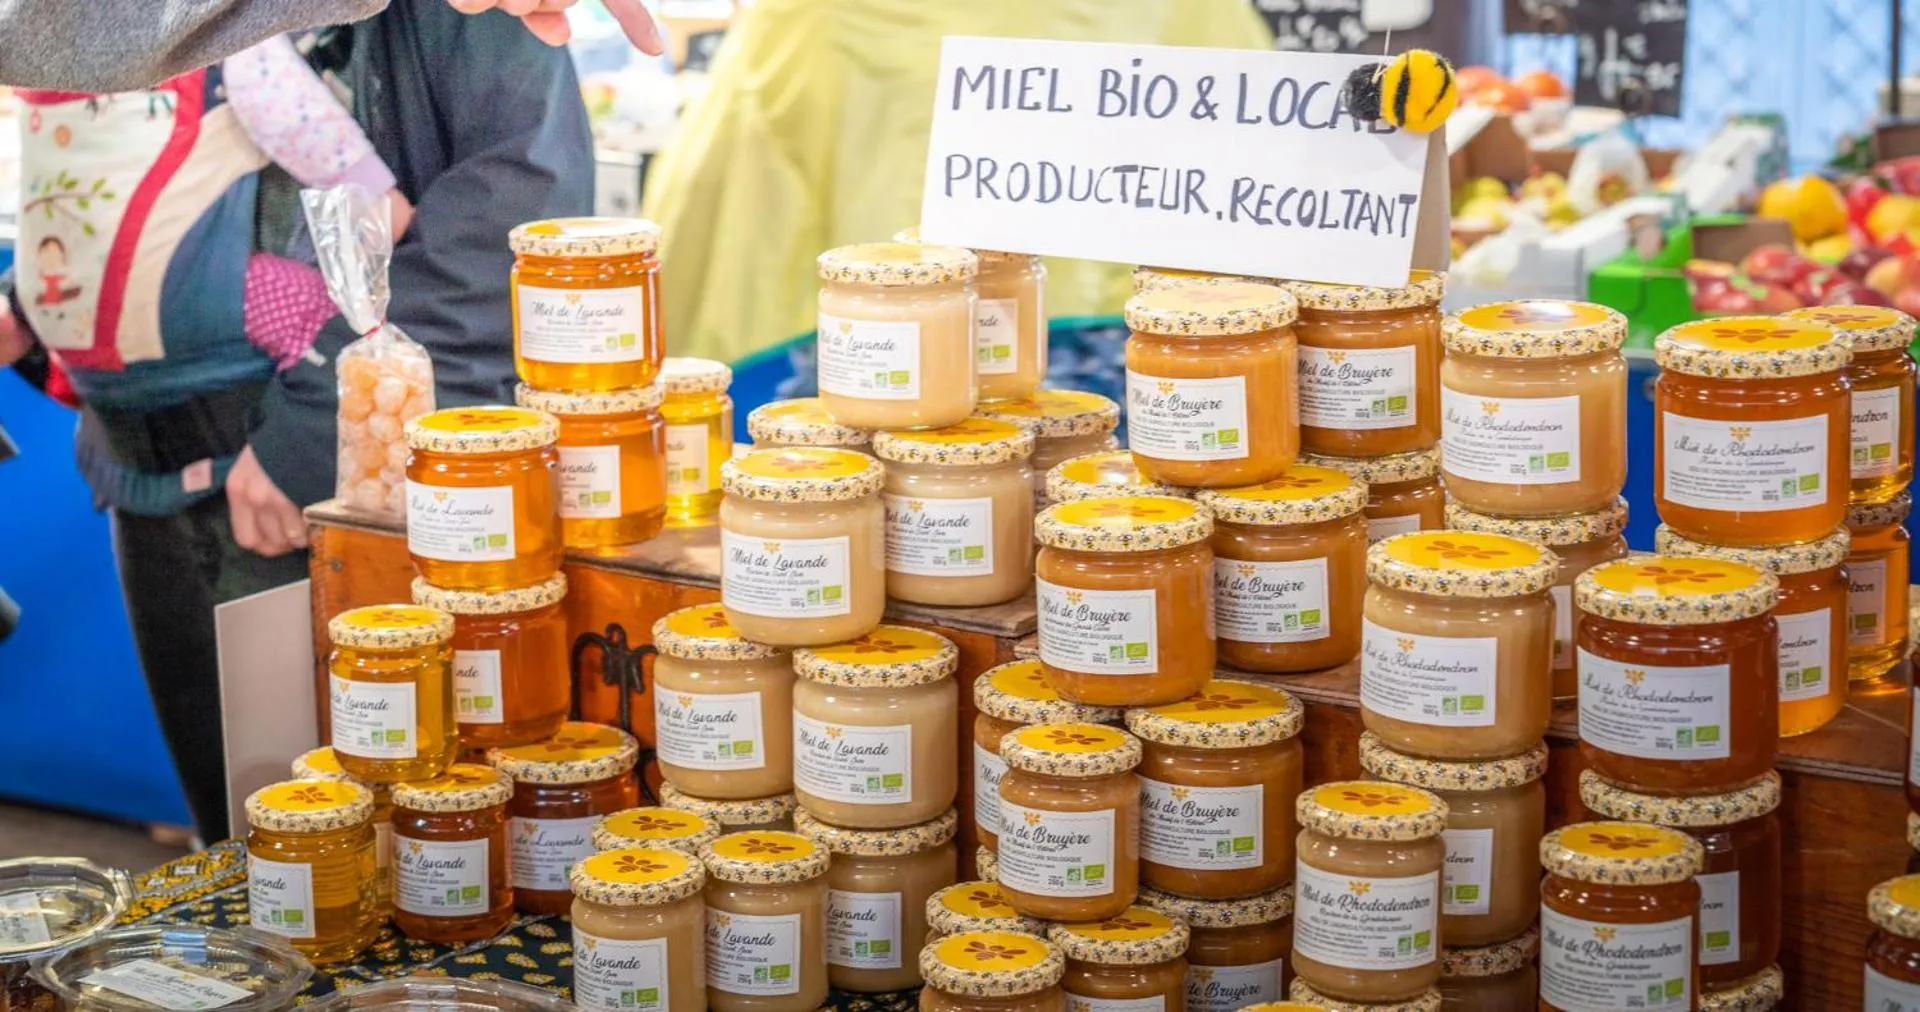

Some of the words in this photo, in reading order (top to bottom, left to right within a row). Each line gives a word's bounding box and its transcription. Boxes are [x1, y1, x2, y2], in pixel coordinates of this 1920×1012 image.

[952, 66, 1073, 113] MIEL
[1190, 77, 1220, 121] &
[847, 334, 896, 352] Lavande
[1319, 364, 1336, 379] de
[1338, 362, 1393, 385] Bruyère
[1151, 395, 1166, 409] de
[1167, 392, 1223, 418] Bruyère
[1474, 416, 1563, 432] Rhododendron
[1701, 443, 1718, 455] de
[1720, 441, 1815, 458] Rhododendron
[900, 512, 913, 526] de
[916, 511, 972, 530] Lavande
[755, 554, 769, 568] de
[772, 553, 829, 573] Lavande
[1231, 577, 1245, 591] de
[1248, 576, 1306, 599] Bruyère
[1061, 604, 1074, 619] de
[1076, 603, 1132, 626] Bruyère
[1390, 651, 1479, 674] Rhododendron
[345, 694, 391, 711] Lavande
[1617, 683, 1713, 704] Rhododendron
[671, 706, 683, 720] de
[687, 708, 739, 726] Lavande
[817, 739, 831, 751] de
[834, 739, 890, 759] Lavande
[1162, 800, 1179, 815] de
[1180, 799, 1240, 824] Bruyère
[530, 830, 586, 848] Lavande
[1015, 825, 1030, 840] de
[1032, 825, 1091, 850] Bruyère
[402, 853, 413, 865] de
[416, 852, 467, 872] Lavande
[1321, 893, 1335, 908] de
[1337, 893, 1431, 913] Rhododendron
[723, 928, 778, 947] Lavande
[1565, 938, 1578, 953] de
[1581, 938, 1683, 960] Rhododendron
[592, 951, 641, 970] Lavande
[1203, 980, 1262, 1003] Bruyère
